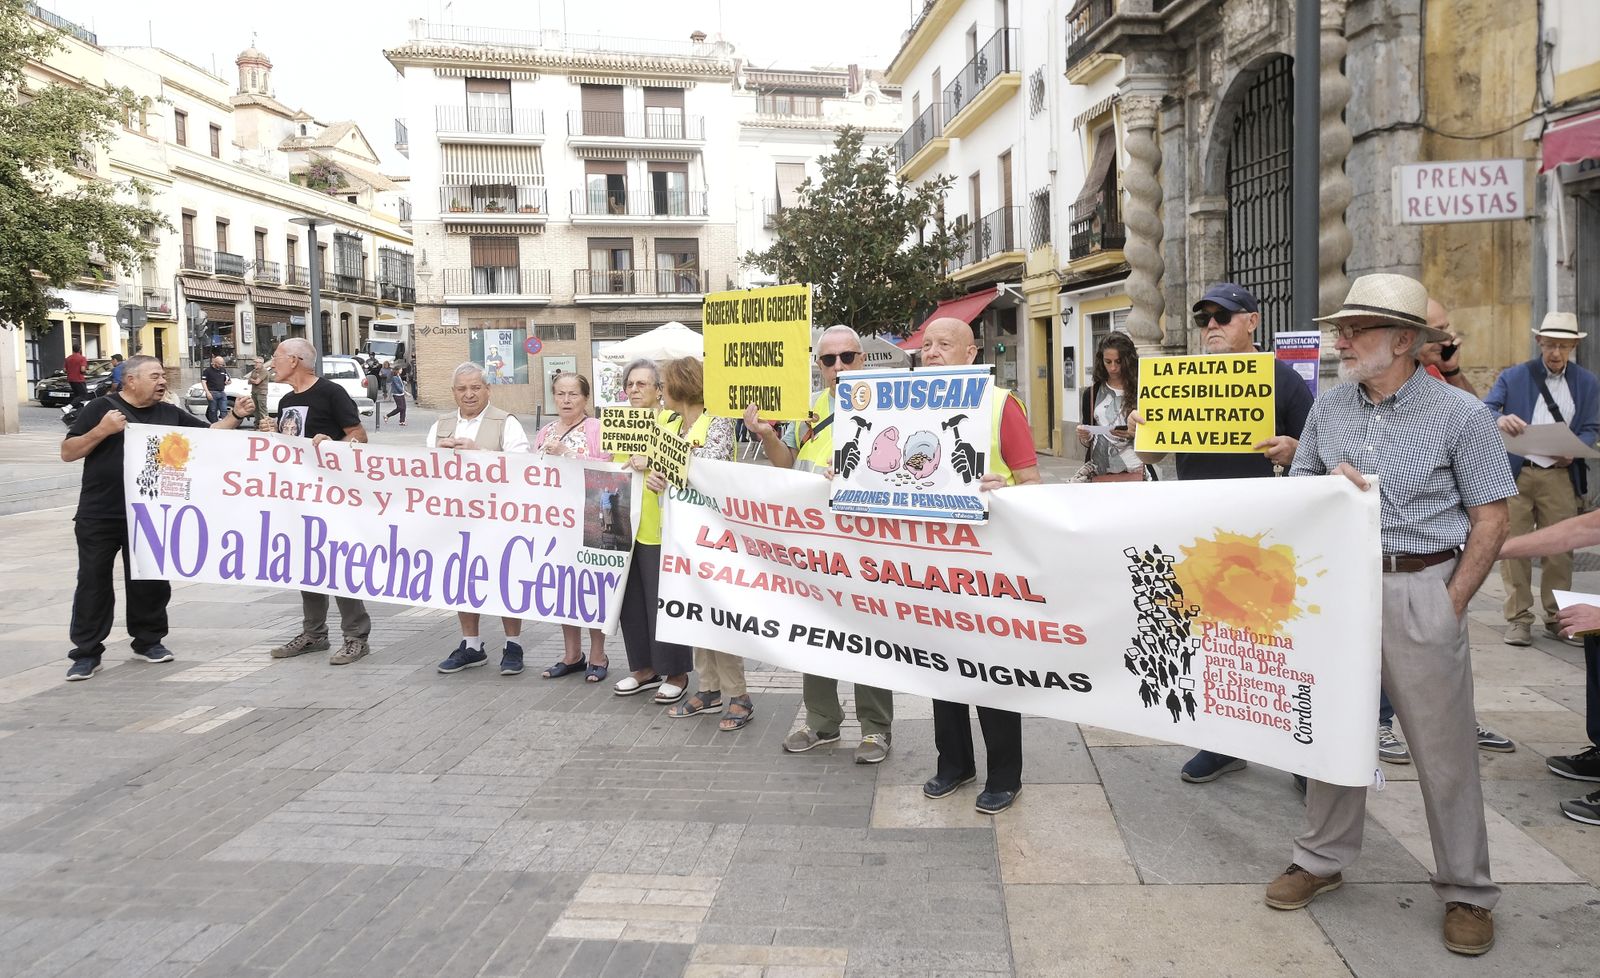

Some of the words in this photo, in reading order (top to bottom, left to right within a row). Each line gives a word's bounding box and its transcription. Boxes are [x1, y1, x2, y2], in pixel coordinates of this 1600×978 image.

[1417, 166, 1509, 189] PRENSA
[1408, 192, 1518, 217] REVISTAS
[706, 300, 739, 325] GOBIERNE
[742, 297, 764, 325] QUIEN
[766, 294, 807, 322] GOBIERNE
[432, 326, 468, 336] CajaSur
[1276, 336, 1319, 345] MANIFESTACIÓN
[724, 342, 738, 368] LAS
[740, 341, 784, 368] PENSIONES
[864, 352, 893, 362] ELTINS
[1153, 363, 1174, 376] LA
[1178, 360, 1226, 376] FALTA
[1233, 360, 1256, 374] DE
[729, 385, 738, 410] SE
[740, 386, 781, 411] DEFIENDEN
[876, 378, 989, 410] BUSCAN
[1139, 384, 1272, 399] ACCESIBILIDAD
[604, 409, 624, 418] ESTA
[629, 410, 639, 418] ES
[644, 411, 654, 419] LA
[1146, 408, 1164, 422] ES
[1168, 408, 1264, 422] MALTRATO
[603, 442, 612, 450] LA
[617, 442, 647, 452] PENSIO
[652, 426, 660, 436] YO
[663, 432, 688, 454] COTIZO
[1155, 432, 1166, 444] A
[1170, 432, 1192, 445] LA
[1197, 432, 1252, 446] VEJEZ
[247, 436, 304, 464] Por
[315, 445, 342, 472] la
[354, 448, 509, 484] Igualdad
[524, 465, 562, 488] en
[660, 442, 686, 466] COTIZAS
[660, 456, 679, 473] ELLOS
[222, 471, 363, 507] Salarios
[373, 490, 392, 516] y
[405, 488, 576, 528] Pensiones
[833, 489, 890, 506] LADRONES
[892, 493, 908, 506] DE
[911, 494, 984, 511] PENSIONES
[722, 496, 826, 530] JUNTAS
[834, 514, 980, 548] CONTRA
[131, 502, 208, 578] NO
[219, 530, 246, 580] a
[256, 510, 292, 584] la
[300, 514, 434, 602] Brecha
[443, 531, 488, 608] de
[500, 536, 622, 624] Géner
[576, 549, 628, 568] CÓRDOB
[695, 526, 738, 552] LA
[741, 534, 852, 578] BRECHA
[859, 556, 1046, 604] SALARIAL
[662, 555, 691, 576] EN
[698, 562, 824, 602] SALARIOS
[826, 588, 843, 606] Y
[850, 593, 888, 617] EN
[895, 602, 1088, 645] PENSIONES
[1202, 621, 1294, 650] Plataforma
[710, 608, 780, 638] UNAS
[788, 624, 949, 672] PENSIONES
[957, 658, 1092, 693] DIGNAS
[1202, 636, 1287, 665] Ciudadana
[1203, 666, 1224, 682] del
[1228, 670, 1286, 696] Sistema
[1205, 654, 1236, 670] para
[1240, 656, 1253, 672] la
[1257, 659, 1316, 686] Defensa
[1204, 679, 1268, 708] Público
[1273, 693, 1292, 714] de
[1204, 696, 1292, 732] Pensiones
[1292, 684, 1314, 745] Córdoba
